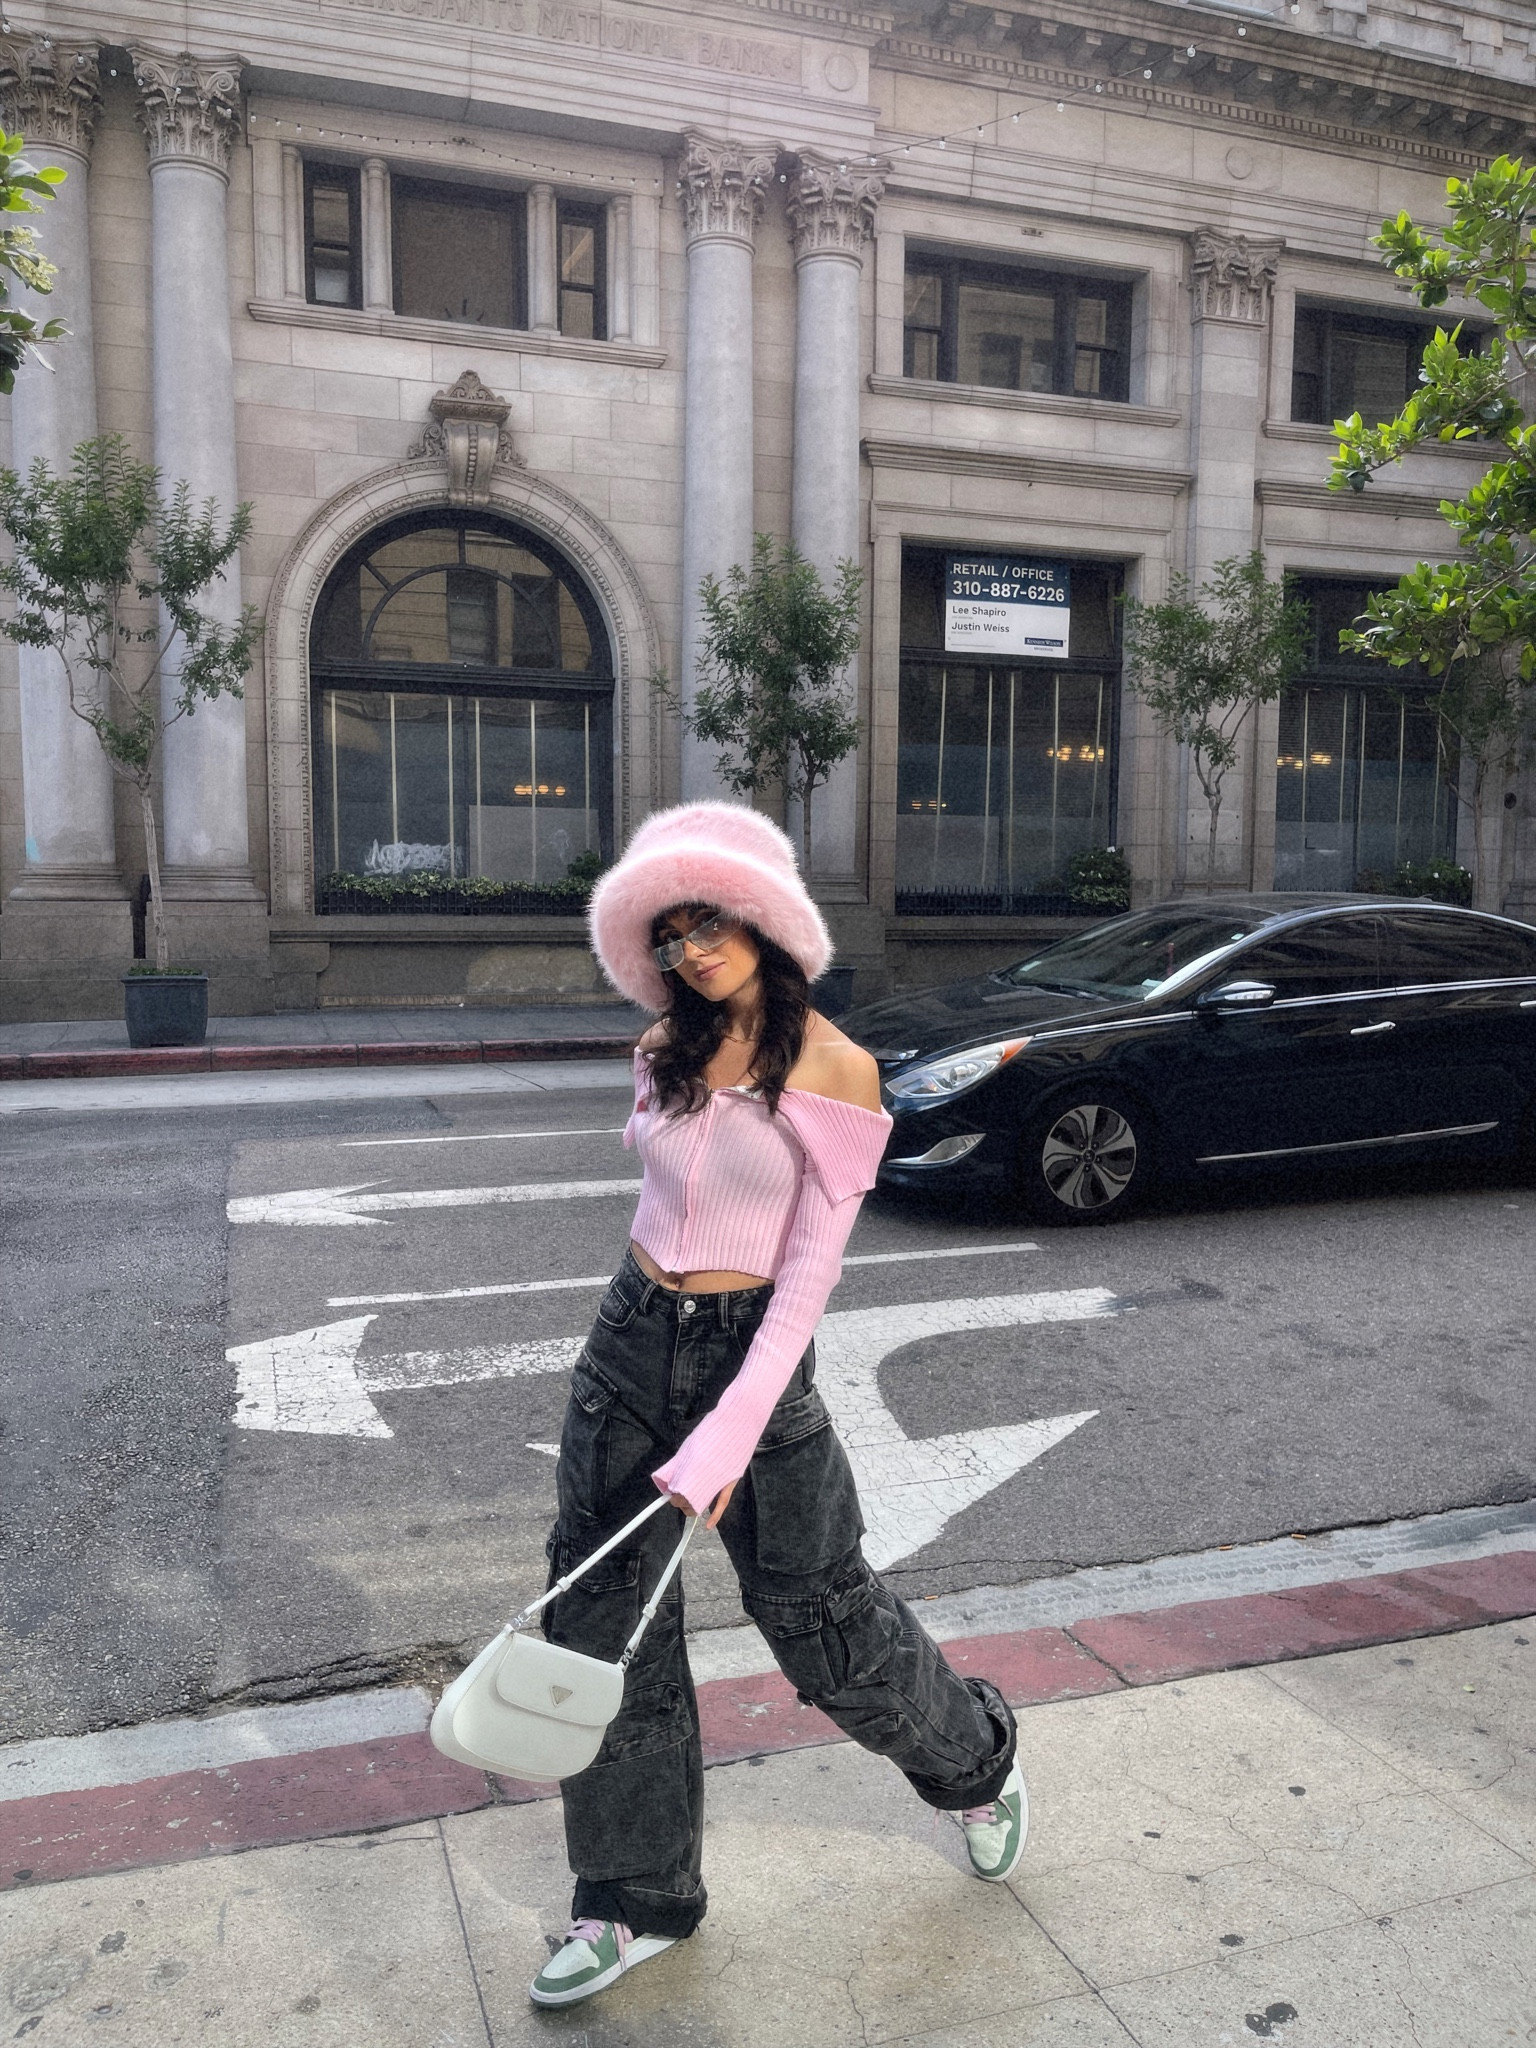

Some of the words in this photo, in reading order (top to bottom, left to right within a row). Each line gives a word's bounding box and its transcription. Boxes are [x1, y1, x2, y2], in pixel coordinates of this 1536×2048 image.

[537, 3, 685, 60] NATIONAL
[698, 32, 776, 74] BANK
[953, 563, 999, 577] RETAIL
[1002, 565, 1008, 578] /
[1011, 566, 1054, 581] OFFICE
[952, 580, 1065, 602] 310-887-6226
[952, 606, 969, 614] Lee
[971, 606, 1007, 618] Shapiro
[951, 622, 981, 631] Justin
[983, 623, 1010, 633] Weiss
